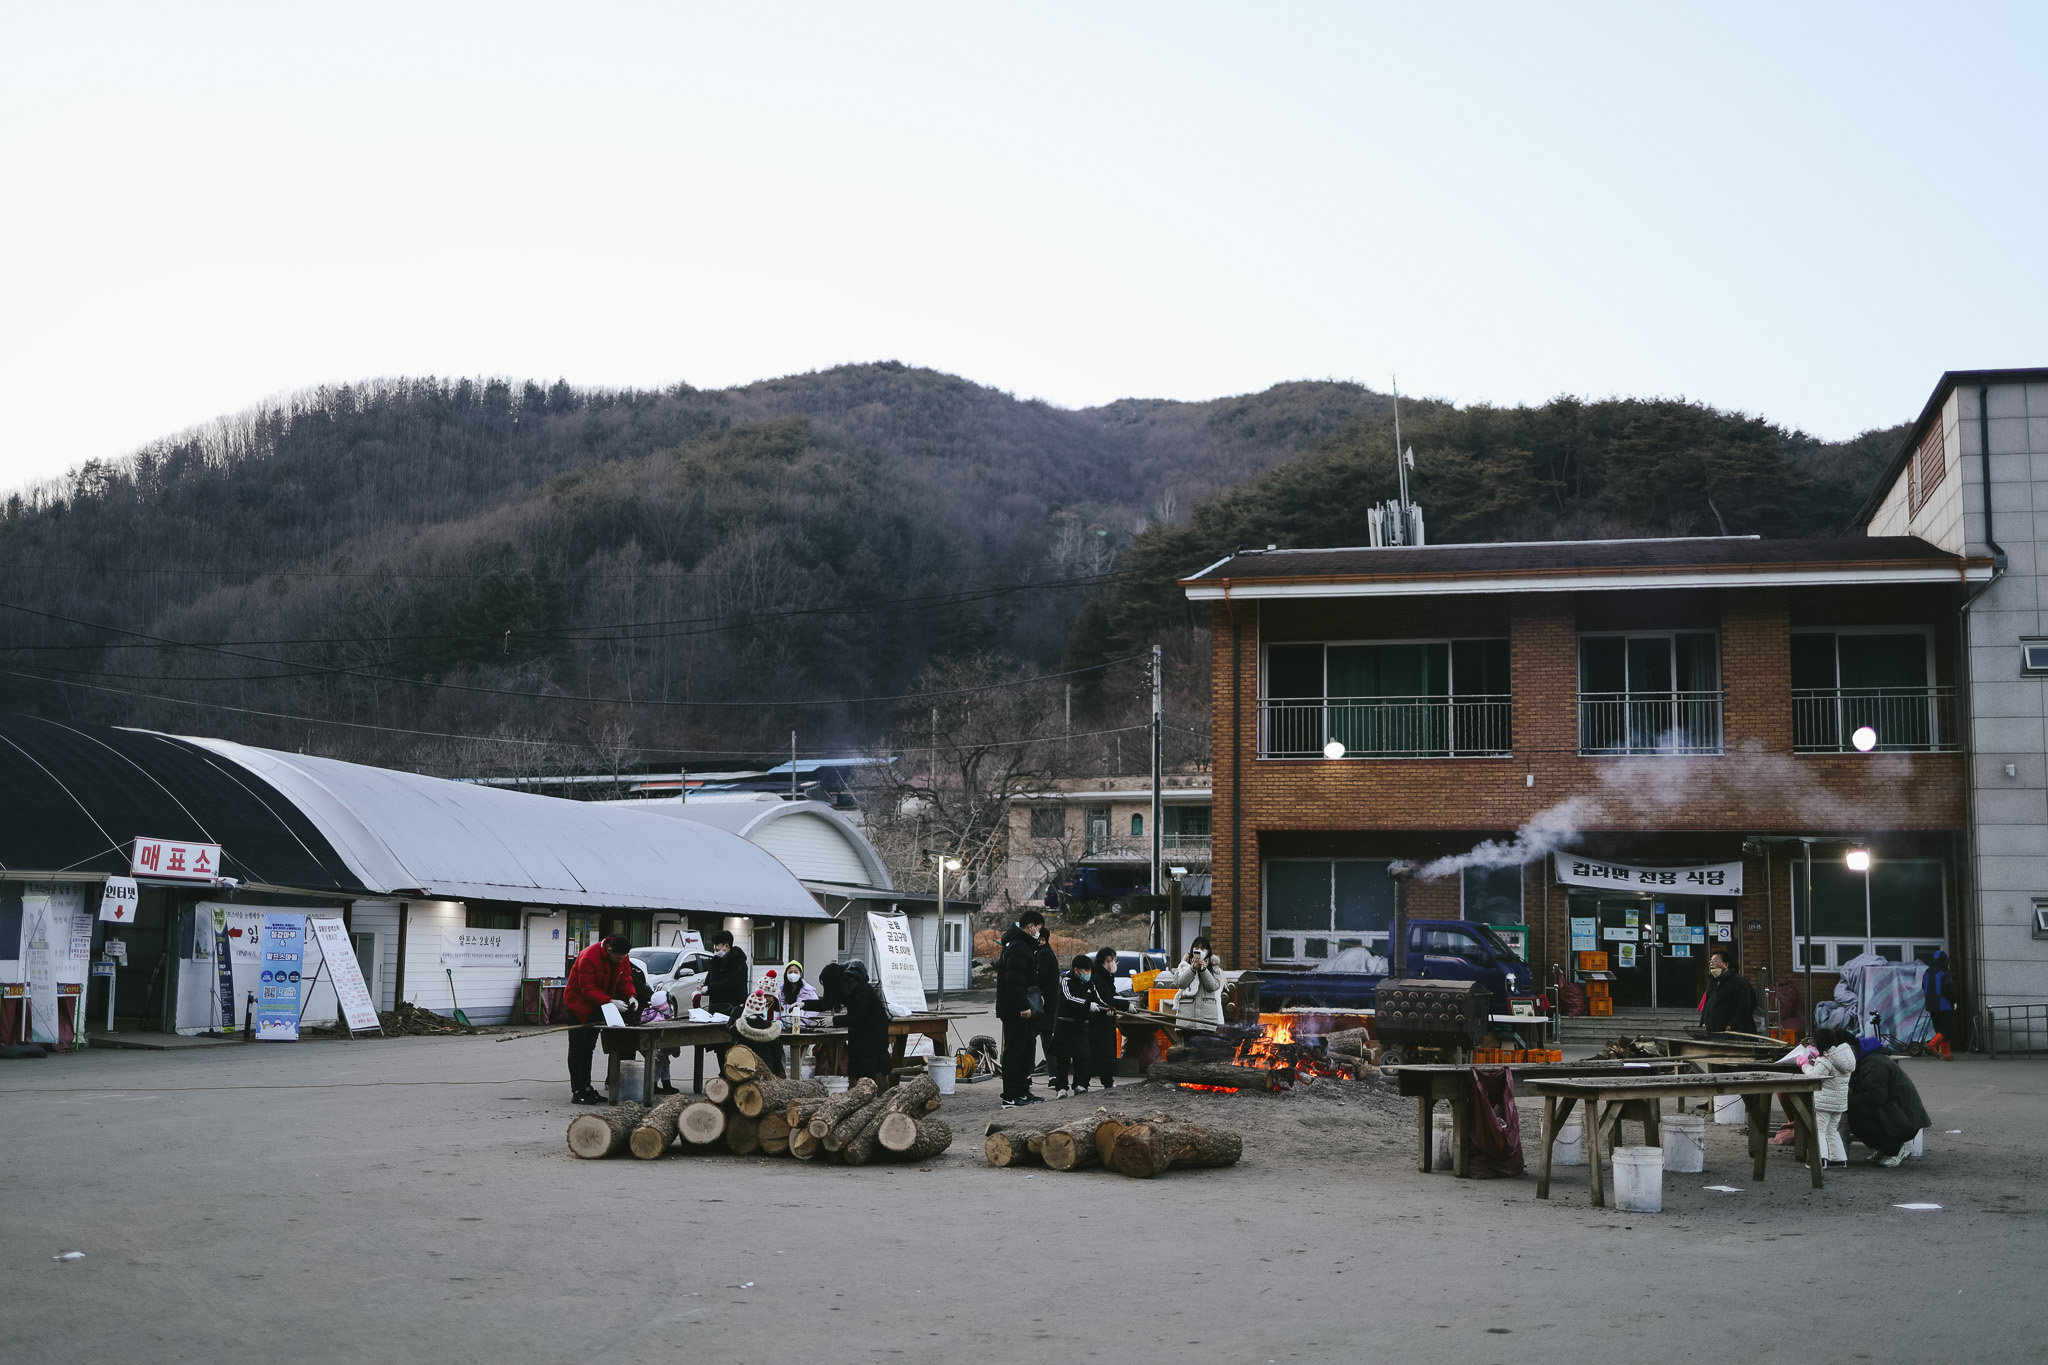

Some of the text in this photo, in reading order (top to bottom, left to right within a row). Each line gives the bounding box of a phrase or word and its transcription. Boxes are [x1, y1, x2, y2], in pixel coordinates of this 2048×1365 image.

[141, 844, 212, 874] 매표소
[1572, 861, 1726, 885] 컵라면 전용 식당
[105, 885, 136, 899] 인터넷
[226, 911, 243, 919] 프스마을
[459, 935, 476, 946] 알프스
[266, 952, 298, 961] 알프스마을
